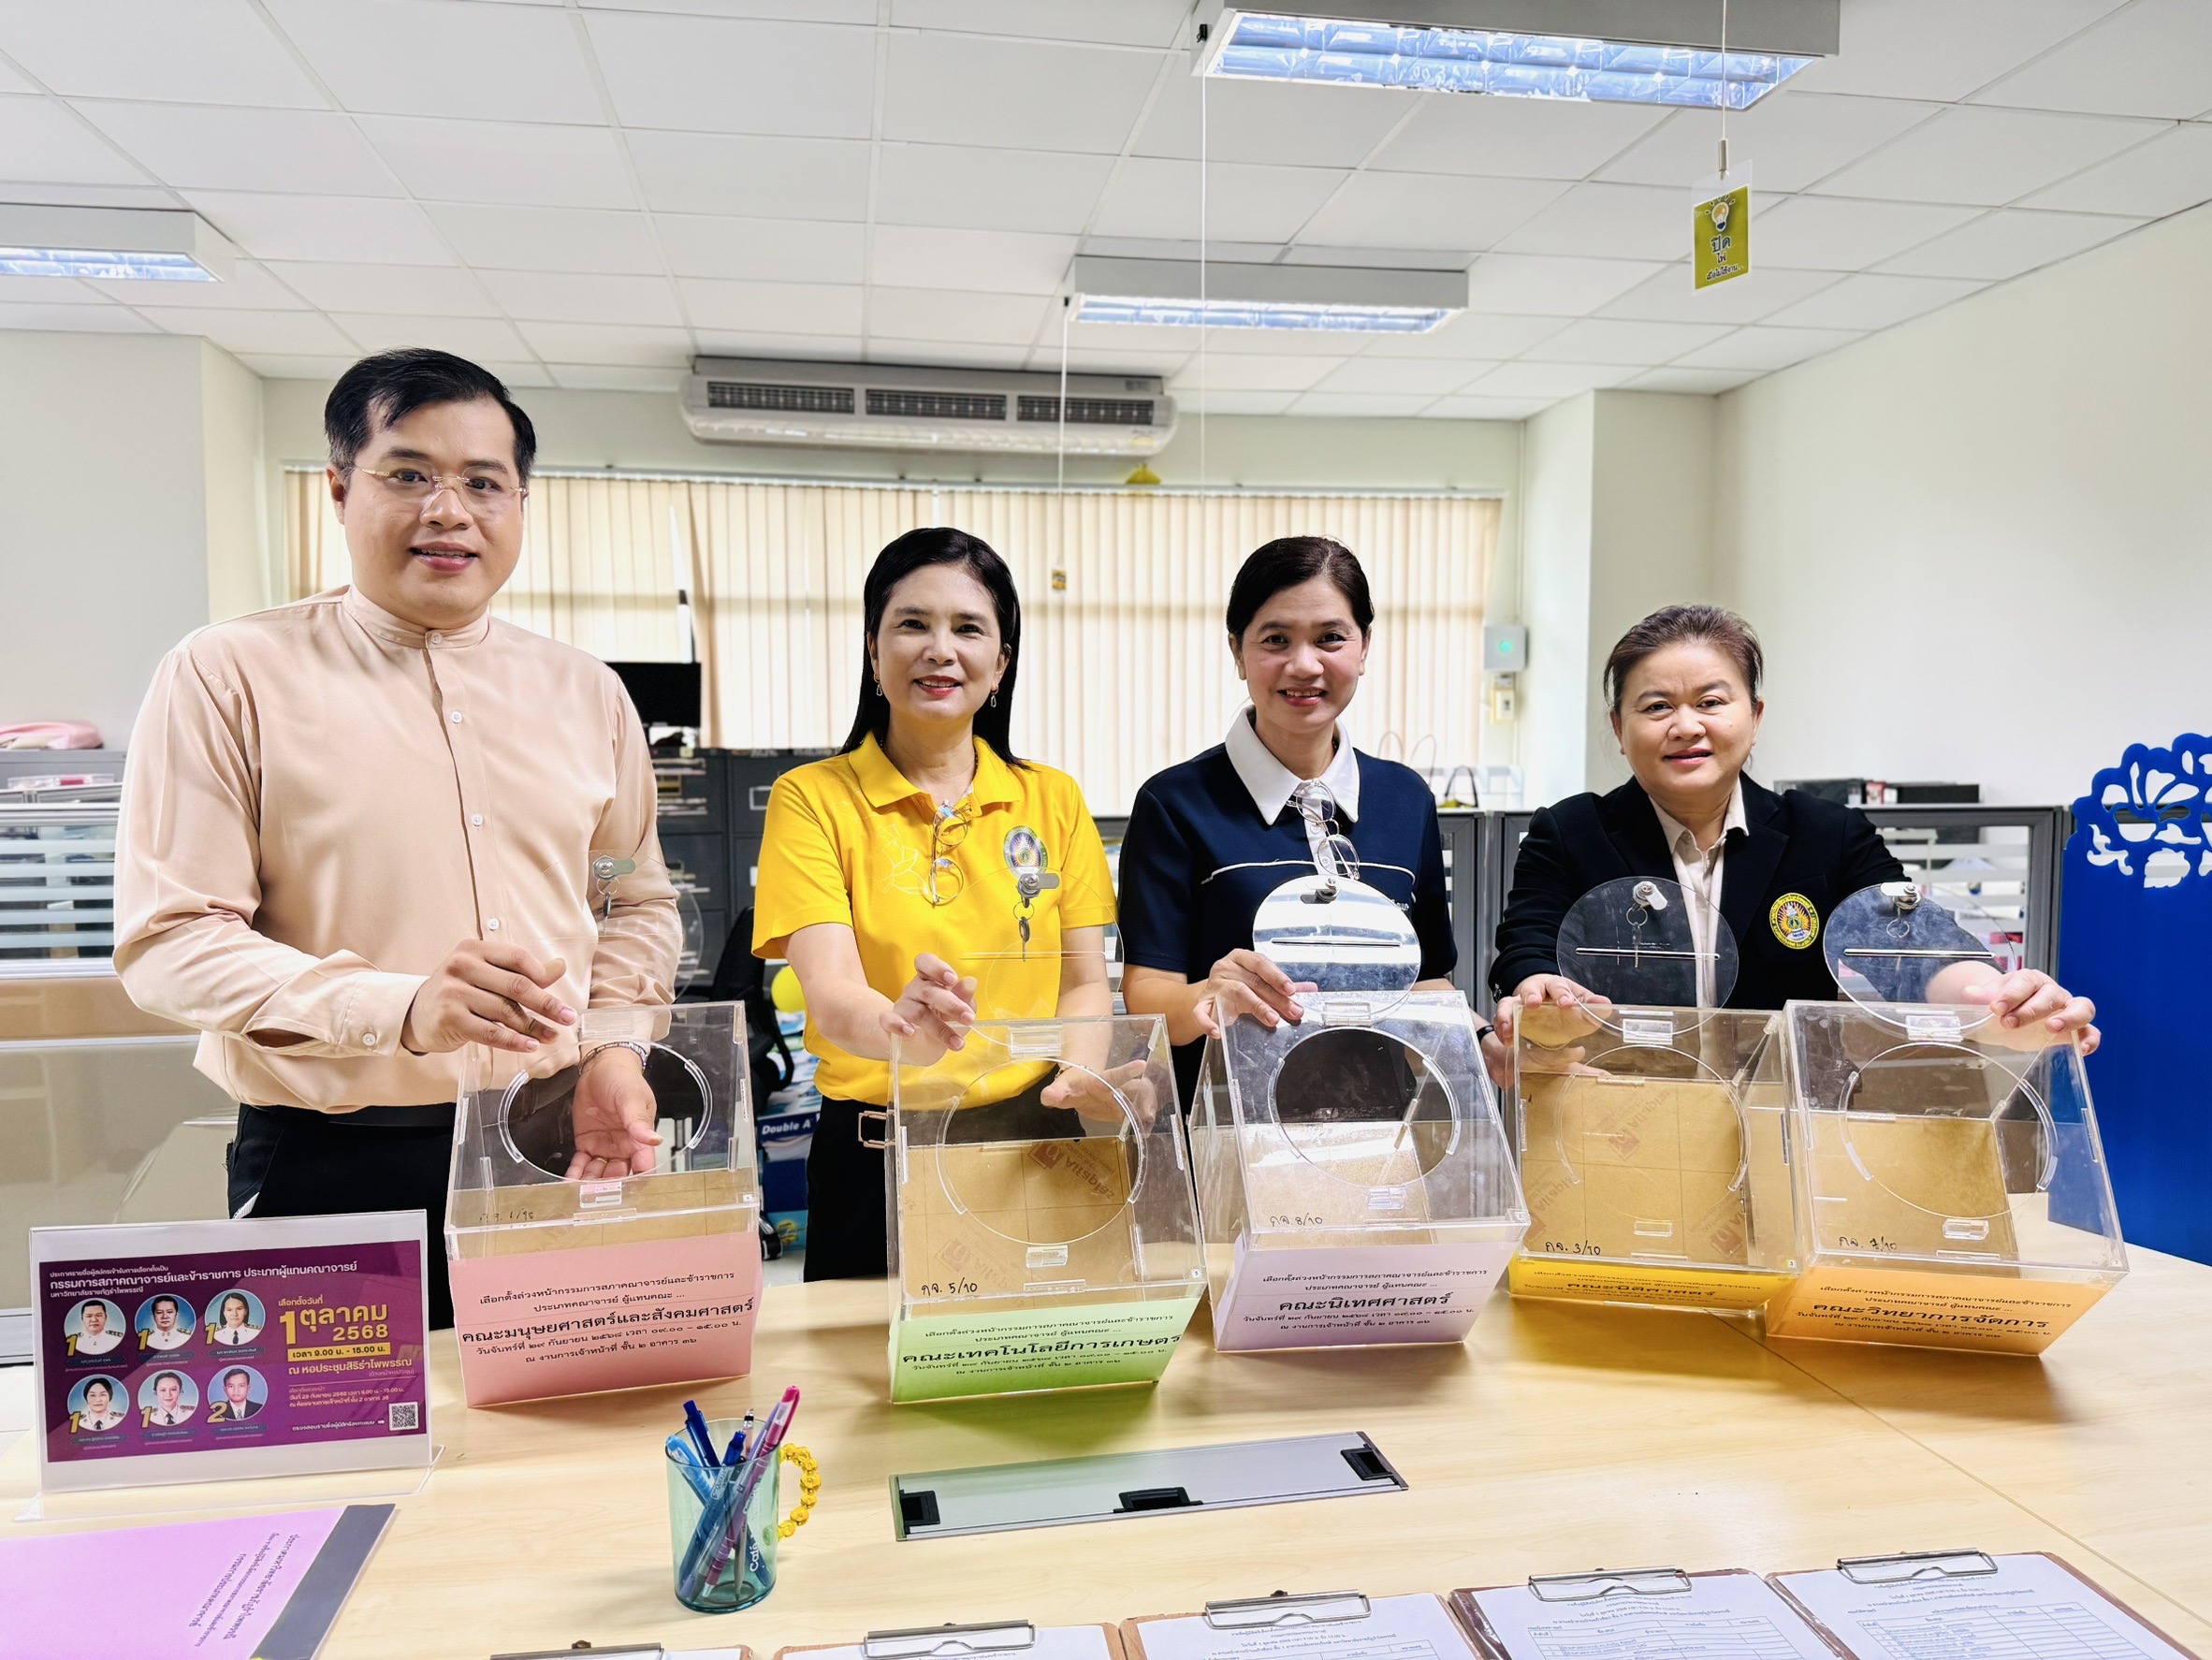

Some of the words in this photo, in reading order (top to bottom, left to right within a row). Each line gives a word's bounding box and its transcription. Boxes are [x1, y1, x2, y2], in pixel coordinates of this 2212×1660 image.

[1710, 235, 1731, 254] ปิด
[1716, 252, 1726, 264] ไฟ
[762, 1121, 800, 1135] Double
[802, 1118, 811, 1129] A
[1294, 1212, 1323, 1226] 8/10
[1573, 1239, 1601, 1256] 3/10
[50, 1269, 241, 1289] กรรมการสภาคณาจารย์และข้าราชการ
[243, 1260, 357, 1278] ประเภทผู้แทนคณาจารย์
[948, 1276, 978, 1294] 5/10
[278, 1294, 324, 1306] เลือกตั้งวันที่
[533, 1295, 618, 1312] ประเภทคณาจารย์
[622, 1292, 673, 1304] ผู้แทนคณะ
[1279, 1291, 1454, 1311] คณะนิเทศศาสตร์
[280, 1311, 296, 1345] 1
[299, 1304, 387, 1332] ตุลาคม
[462, 1296, 754, 1343] คณะมนุษยศาสตร์และสังคมศาสตร์
[1813, 1304, 2050, 1328] คณะวิทยาการจัดการ
[138, 1329, 150, 1350] 1
[205, 1323, 217, 1345] 1
[332, 1324, 388, 1341] 2568
[65, 1334, 78, 1356] 1
[476, 1341, 526, 1355] วันจันทร์ที่
[548, 1335, 588, 1347] กันยายน
[539, 1343, 618, 1361] งานการเจ้าหน้าที่
[621, 1341, 634, 1350] ชั้น
[649, 1339, 678, 1347] อาคาร
[902, 1333, 1182, 1362] คณะเทคโนโลยีการเกษตร
[288, 1367, 299, 1376] ณ
[301, 1359, 412, 1375] หอประชุมสิริรำไพพรรณ
[70, 1411, 80, 1434] 1
[140, 1406, 152, 1428] 1
[207, 1402, 227, 1424] 2
